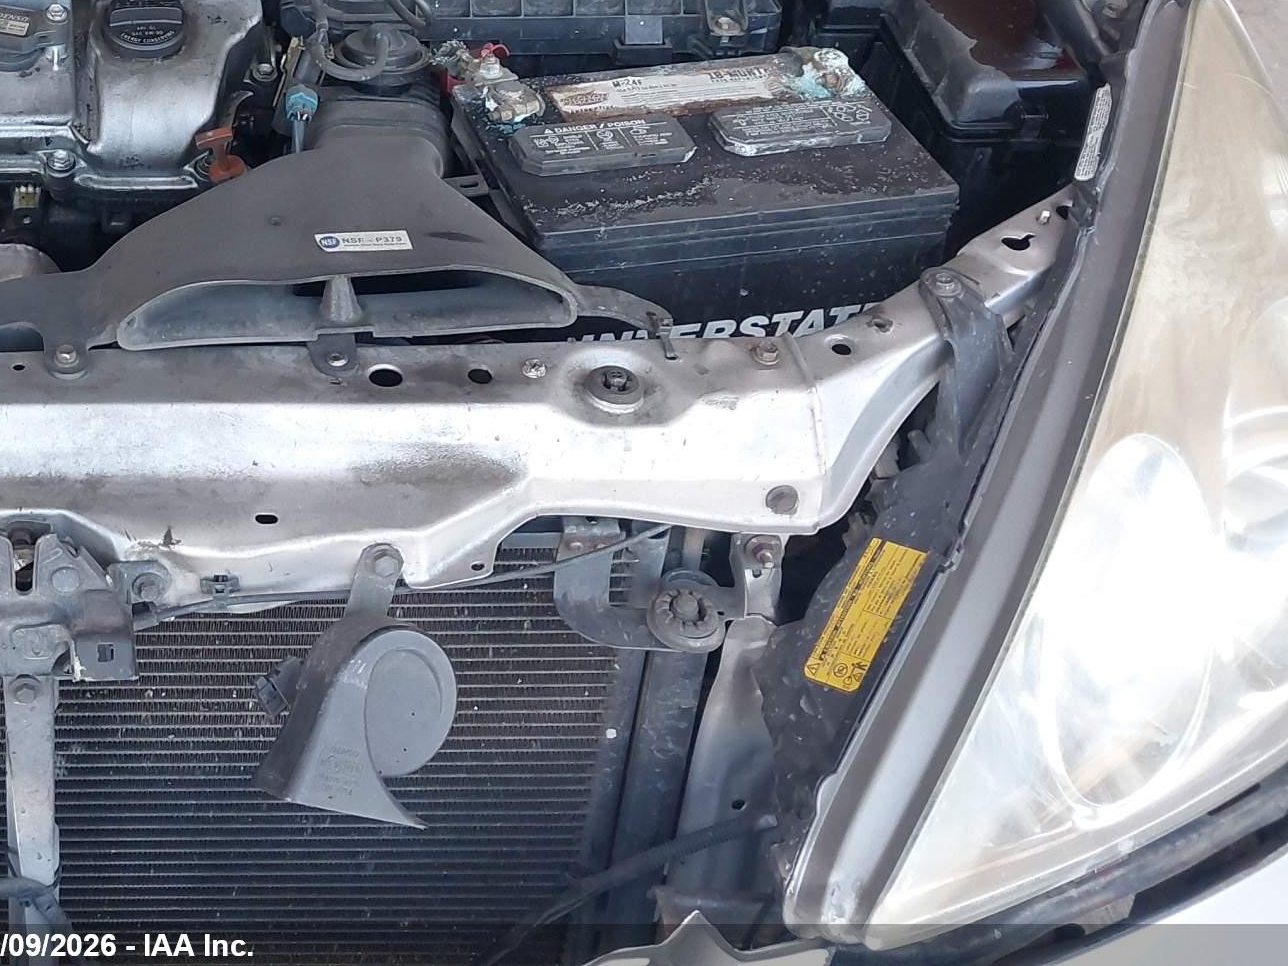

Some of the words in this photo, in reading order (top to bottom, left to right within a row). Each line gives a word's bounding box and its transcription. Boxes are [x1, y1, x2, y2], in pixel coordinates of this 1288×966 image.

[553, 123, 598, 134] DANGER
[608, 119, 646, 129] POISON
[320, 237, 338, 247] NSF
